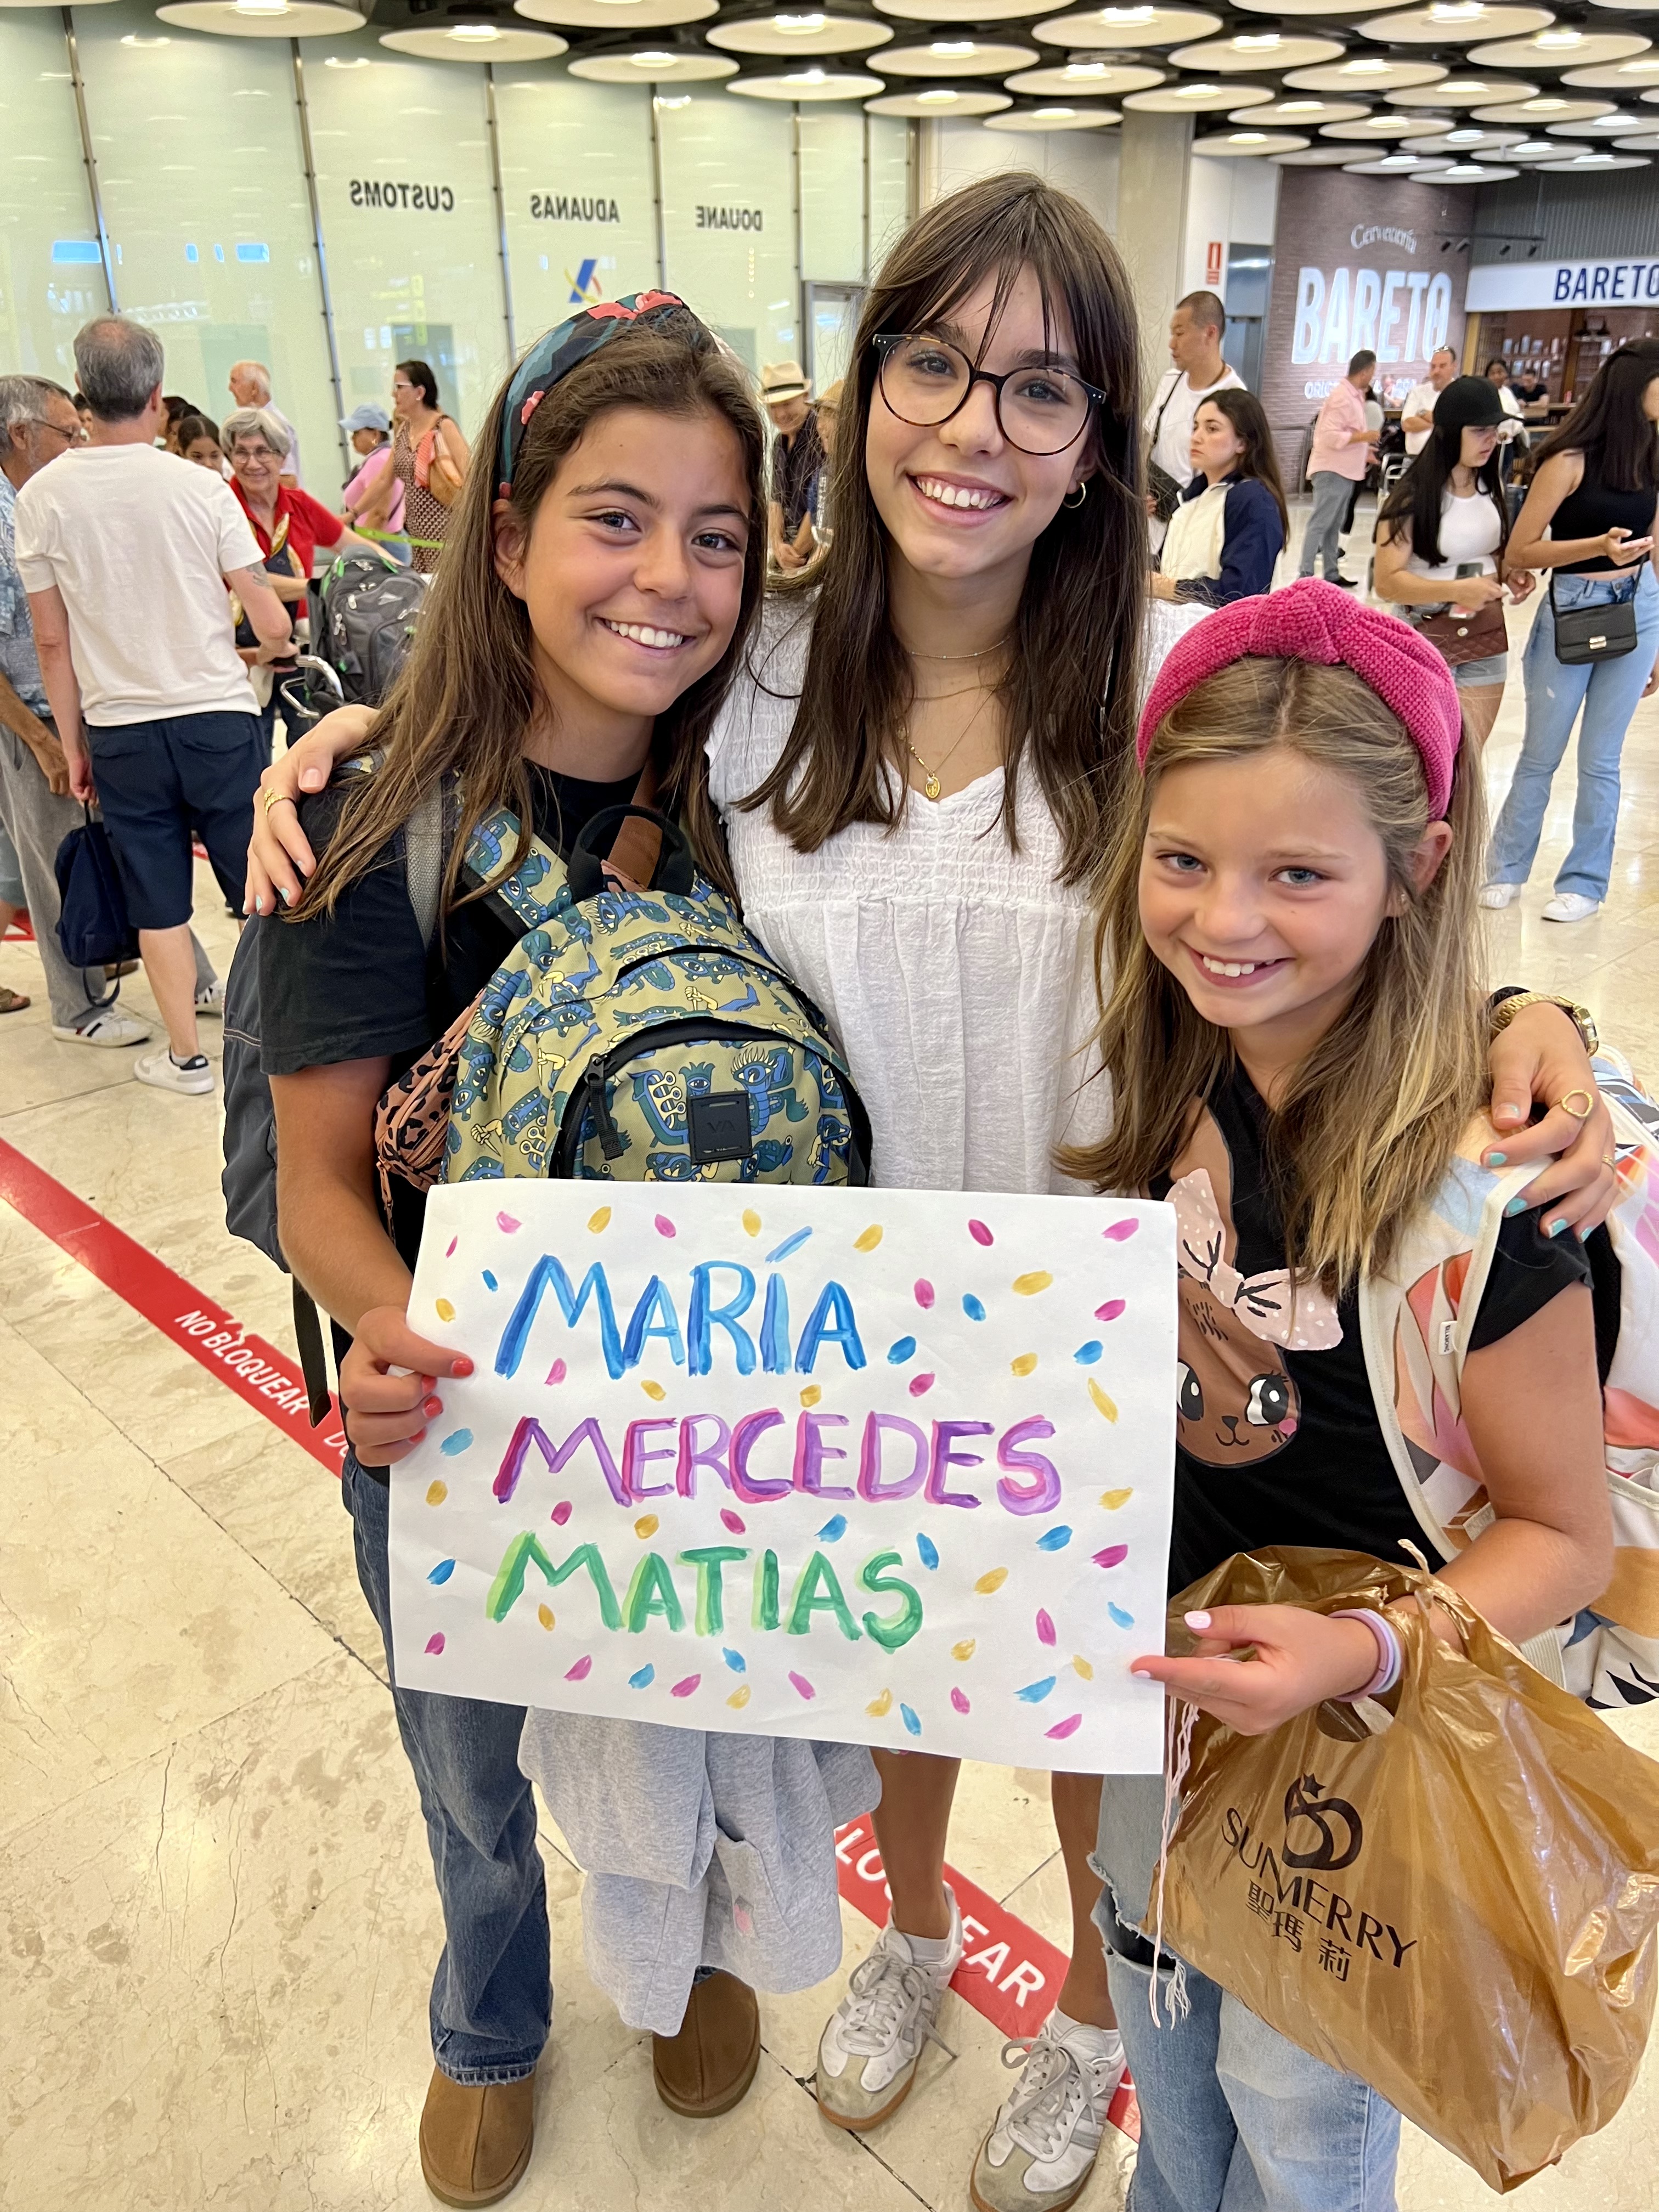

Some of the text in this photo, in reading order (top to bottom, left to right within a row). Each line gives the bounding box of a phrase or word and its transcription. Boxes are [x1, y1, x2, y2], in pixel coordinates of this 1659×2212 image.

[1291, 267, 1452, 364] BARETO
[1555, 264, 1659, 300] BARETO
[495, 1227, 867, 1380] MARÍA
[174, 1310, 309, 1415] NO BLOQUEAR
[492, 1408, 1061, 1516] MERCEDES
[486, 1531, 923, 1654] MATIAS
[834, 1822, 1046, 2007] LOEAR
[1221, 1808, 1417, 1968] SUNMERRY
